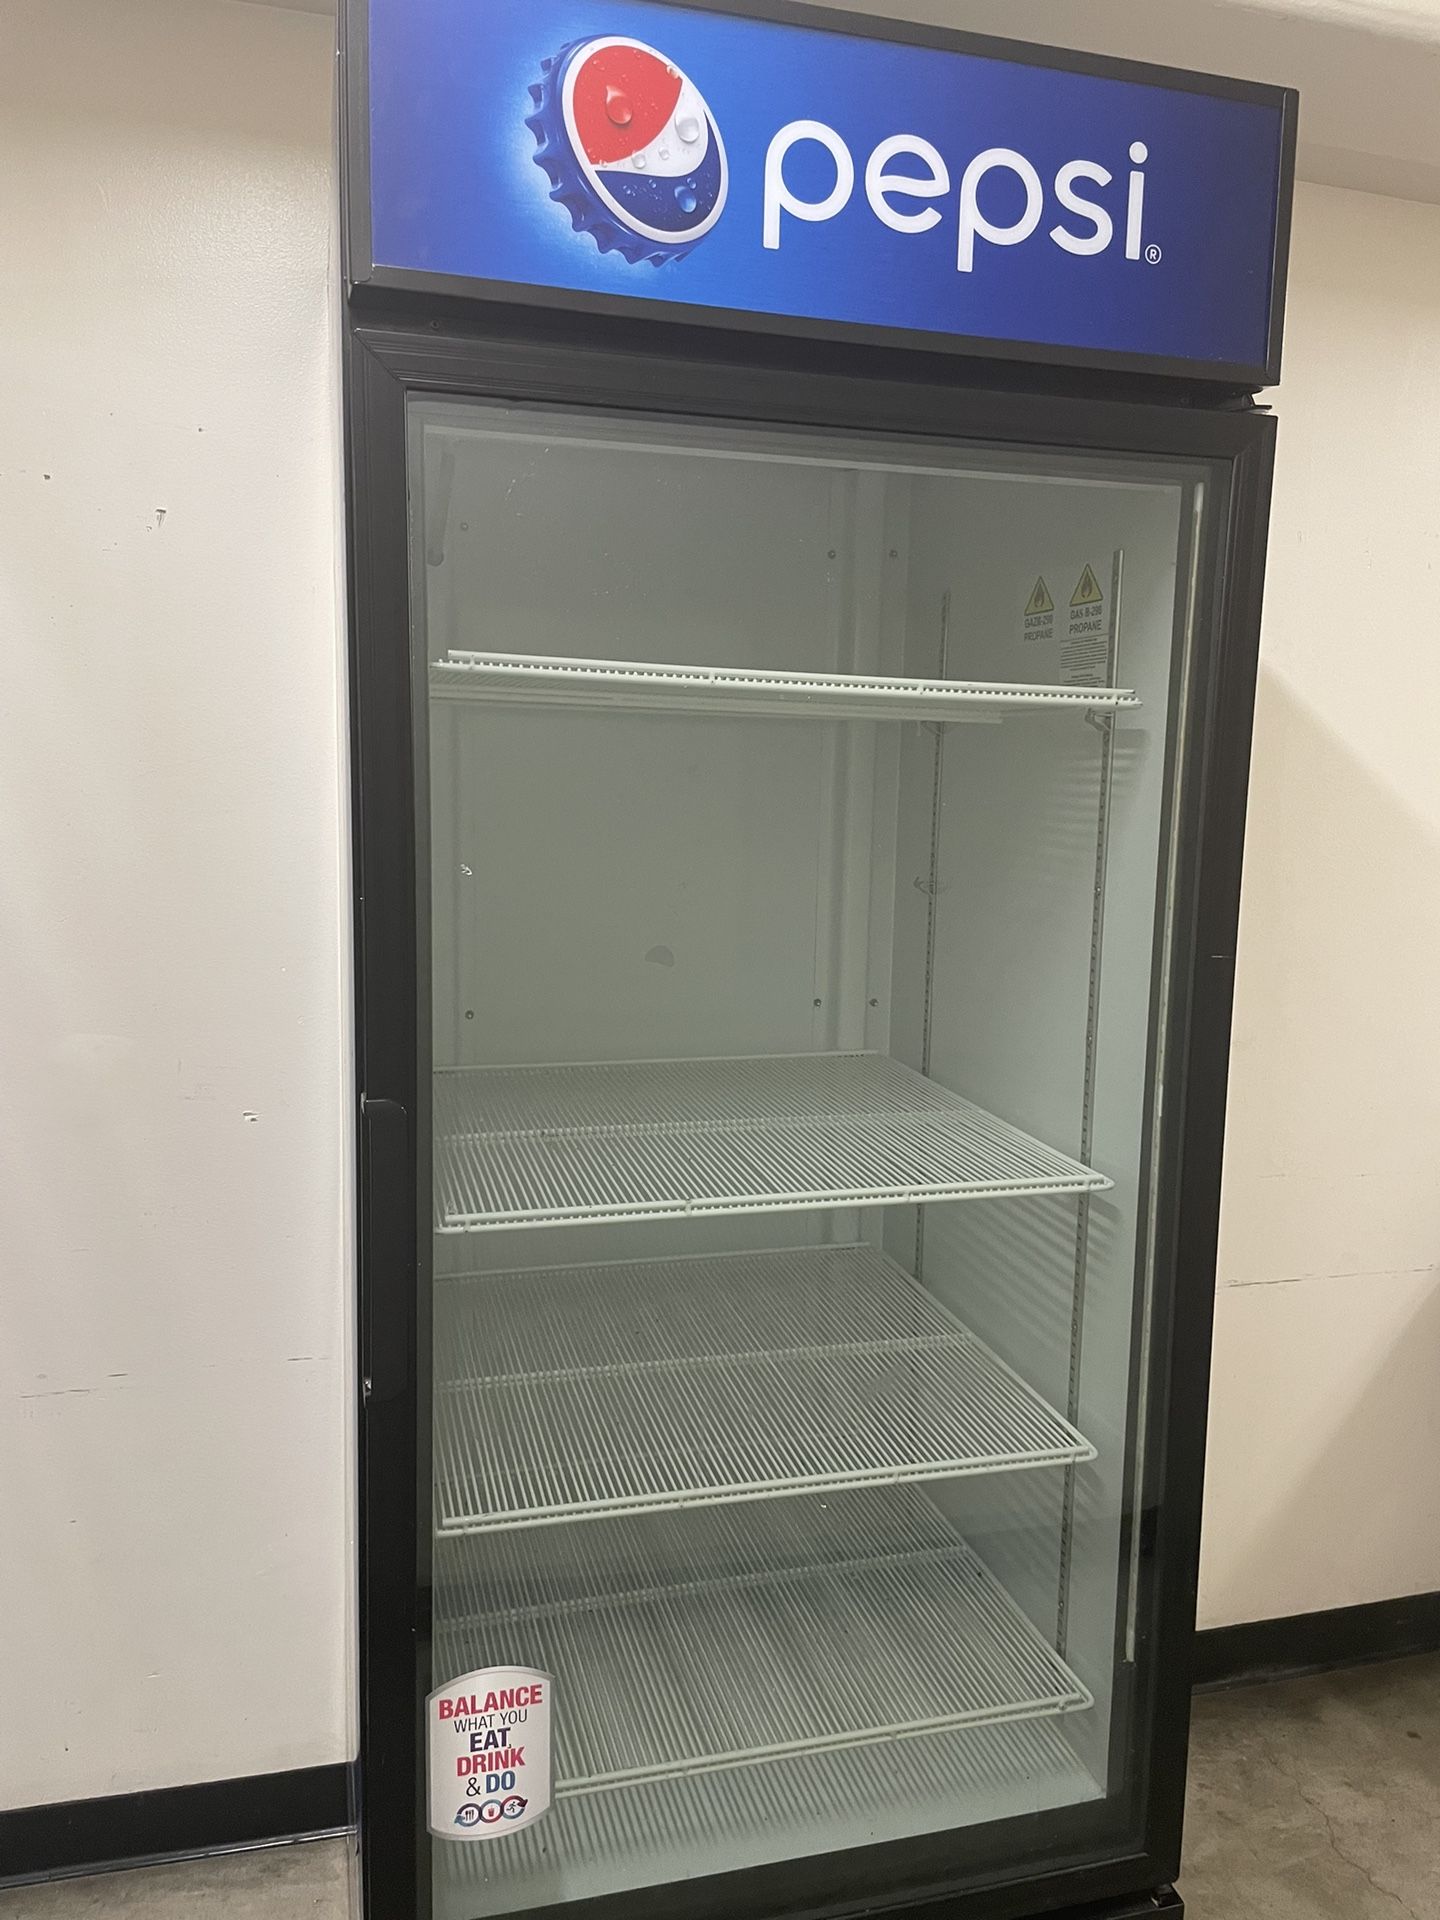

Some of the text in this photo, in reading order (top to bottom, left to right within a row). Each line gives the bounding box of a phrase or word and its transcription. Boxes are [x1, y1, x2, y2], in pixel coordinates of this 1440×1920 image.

[763, 119, 1148, 273] pepsi
[1069, 620, 1102, 634] PROPANE
[438, 1684, 543, 1720] BALANCE
[453, 1709, 528, 1733] WHAT YOU
[469, 1727, 512, 1752] EAT,
[456, 1746, 526, 1777] DRINK
[465, 1770, 516, 1797] & DO
